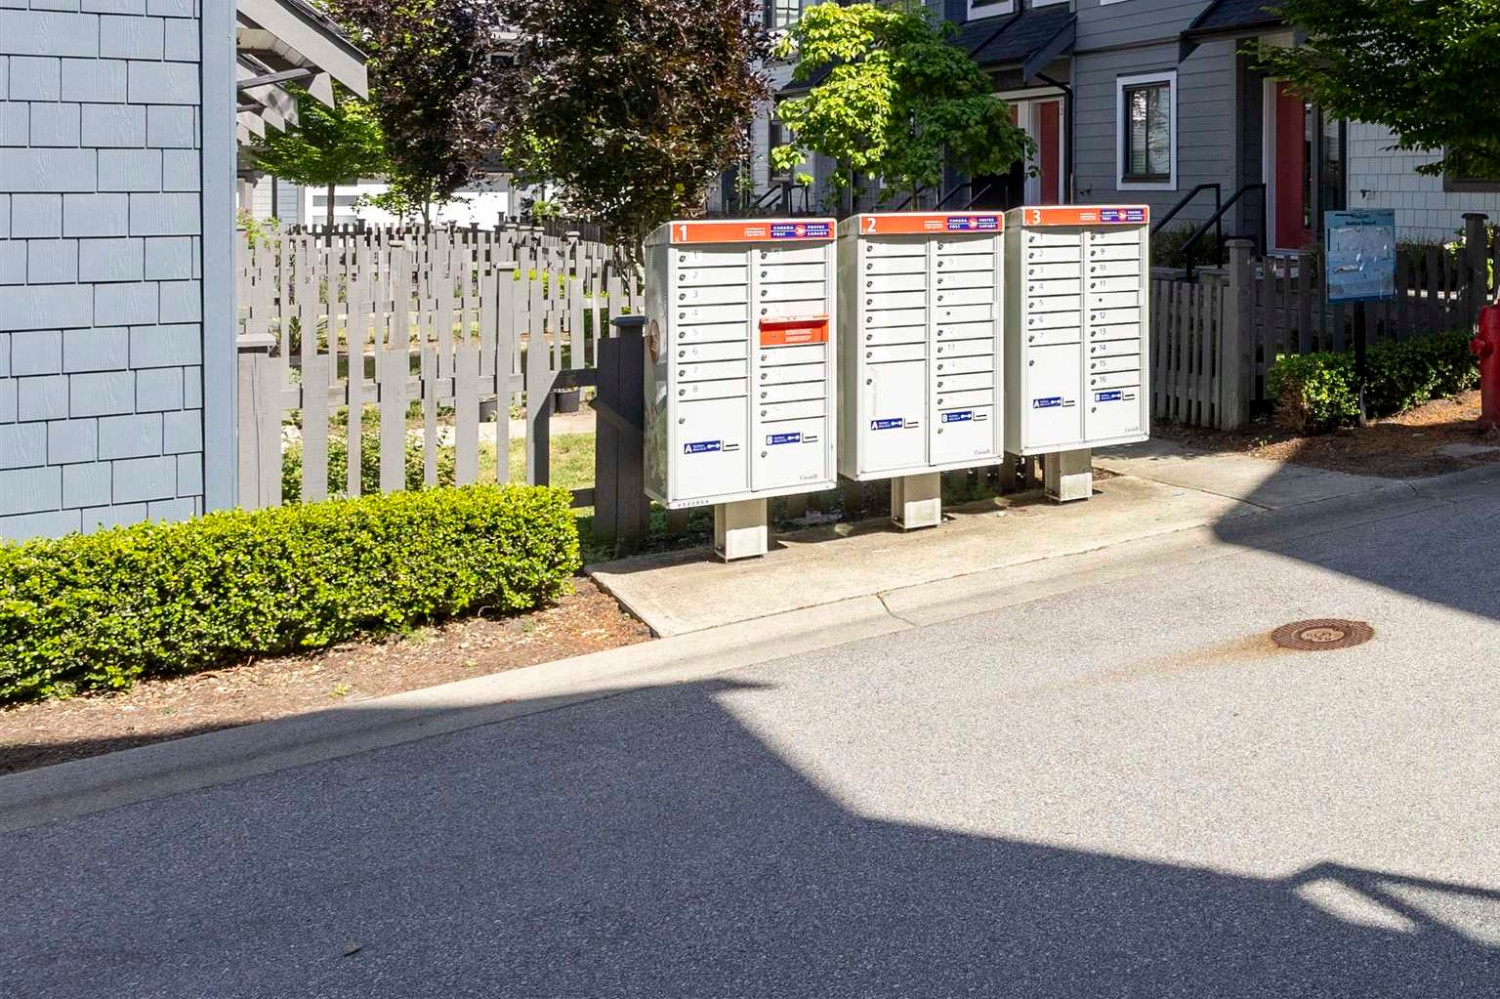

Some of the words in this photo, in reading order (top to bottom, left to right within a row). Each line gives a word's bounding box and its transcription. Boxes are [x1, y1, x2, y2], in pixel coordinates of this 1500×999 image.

[1032, 209, 1041, 224] 3
[867, 217, 876, 232] 2
[679, 224, 688, 242] 1
[1033, 400, 1040, 408] A
[872, 421, 879, 430] A
[766, 434, 773, 445] B
[685, 443, 693, 454] A
